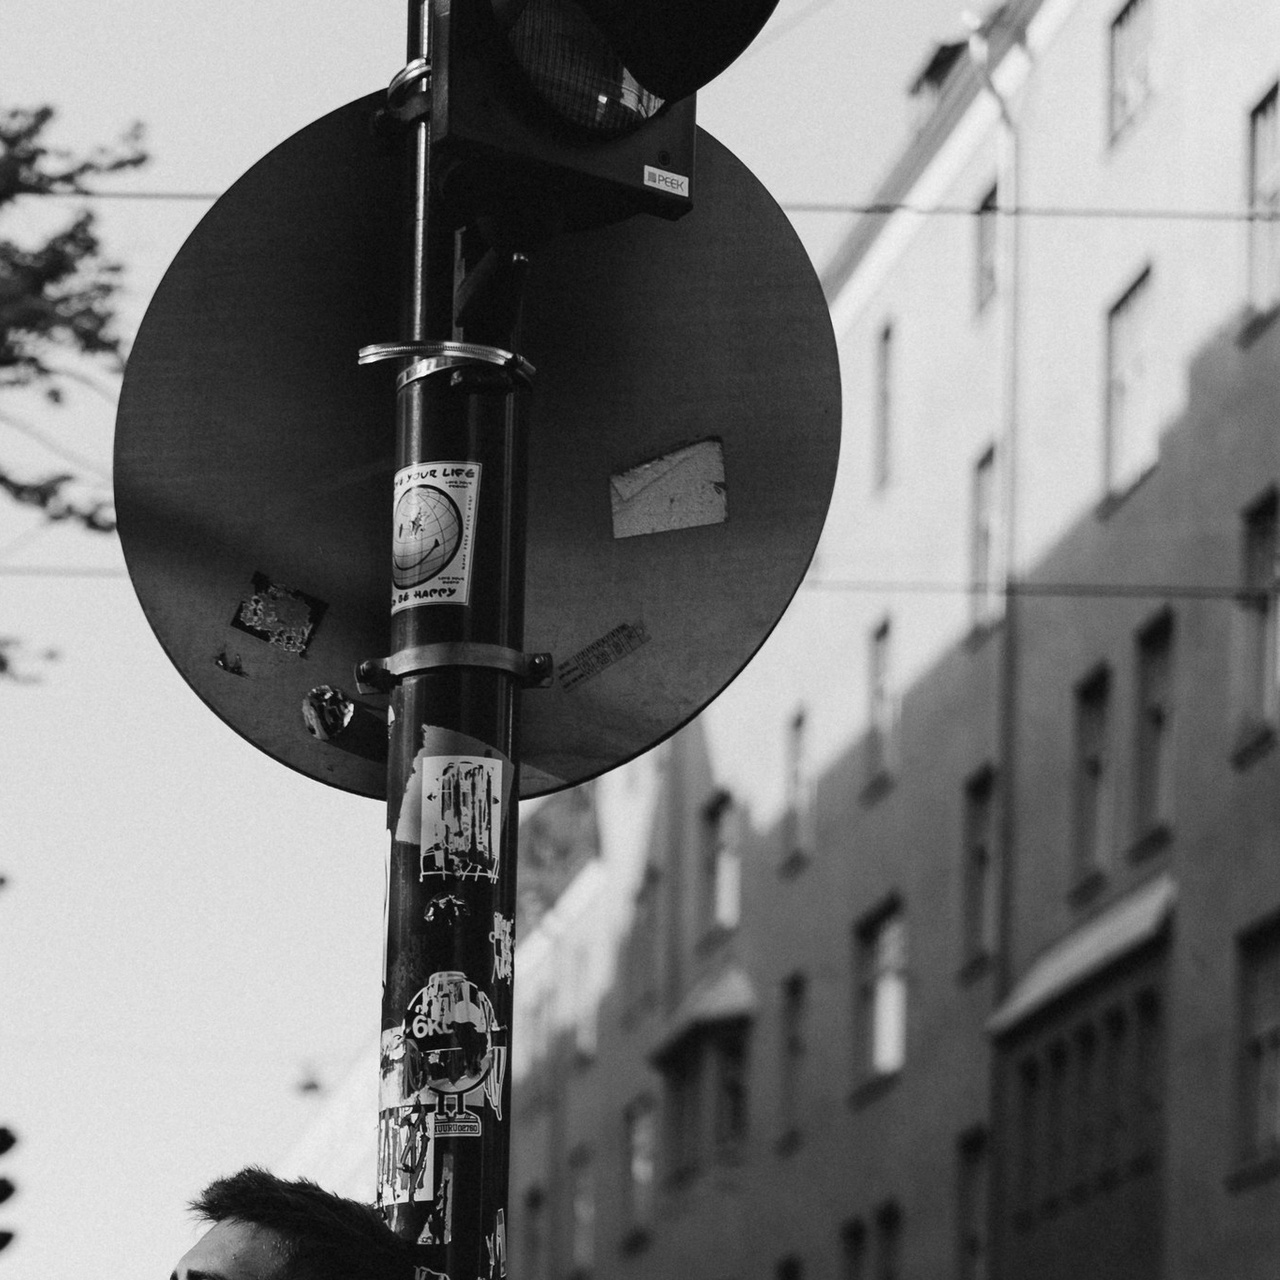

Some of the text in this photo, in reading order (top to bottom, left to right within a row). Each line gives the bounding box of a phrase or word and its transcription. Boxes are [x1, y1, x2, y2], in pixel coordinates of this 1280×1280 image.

[657, 174, 684, 192] PEEK
[406, 469, 437, 483] YOUR
[442, 467, 475, 478] LIFE
[413, 587, 457, 599] HAPPY
